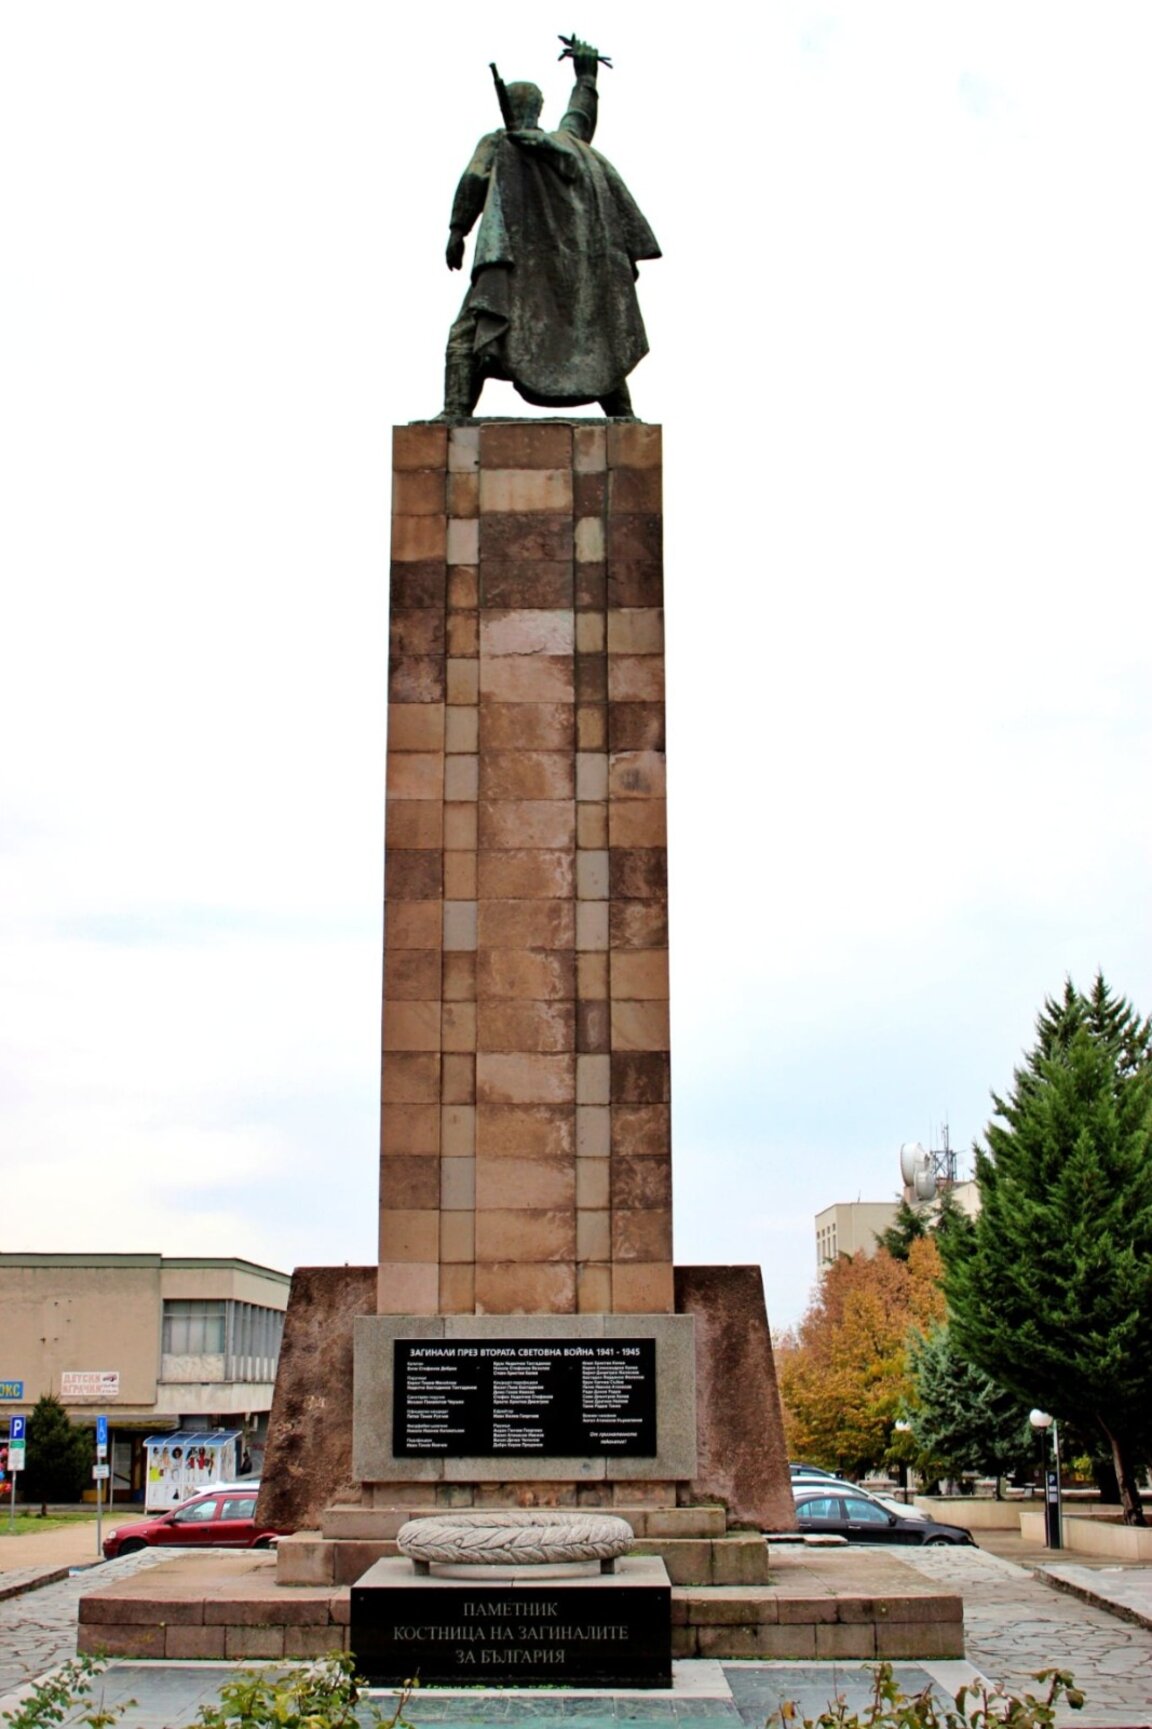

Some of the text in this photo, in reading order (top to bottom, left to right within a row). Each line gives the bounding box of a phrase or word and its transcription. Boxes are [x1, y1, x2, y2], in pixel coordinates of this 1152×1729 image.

[410, 1348, 456, 1357] ЗАГИНАЛИ
[457, 1348, 478, 1357] ПРЕЗ
[480, 1348, 516, 1357] ВТОРАТА
[518, 1348, 562, 1357] СВЕТОВНА
[563, 1346, 594, 1357] ВОЙНА
[596, 1347, 614, 1356] 1941
[622, 1347, 641, 1356] 1945
[14, 1419, 22, 1437] P
[463, 1602, 558, 1617] ПАМЕТНИК
[393, 1626, 629, 1642] КОСТНИЦА НА ЗАГИНАЛИТЕ
[456, 1650, 565, 1664] ЗА БЪЛГАРИЯ
